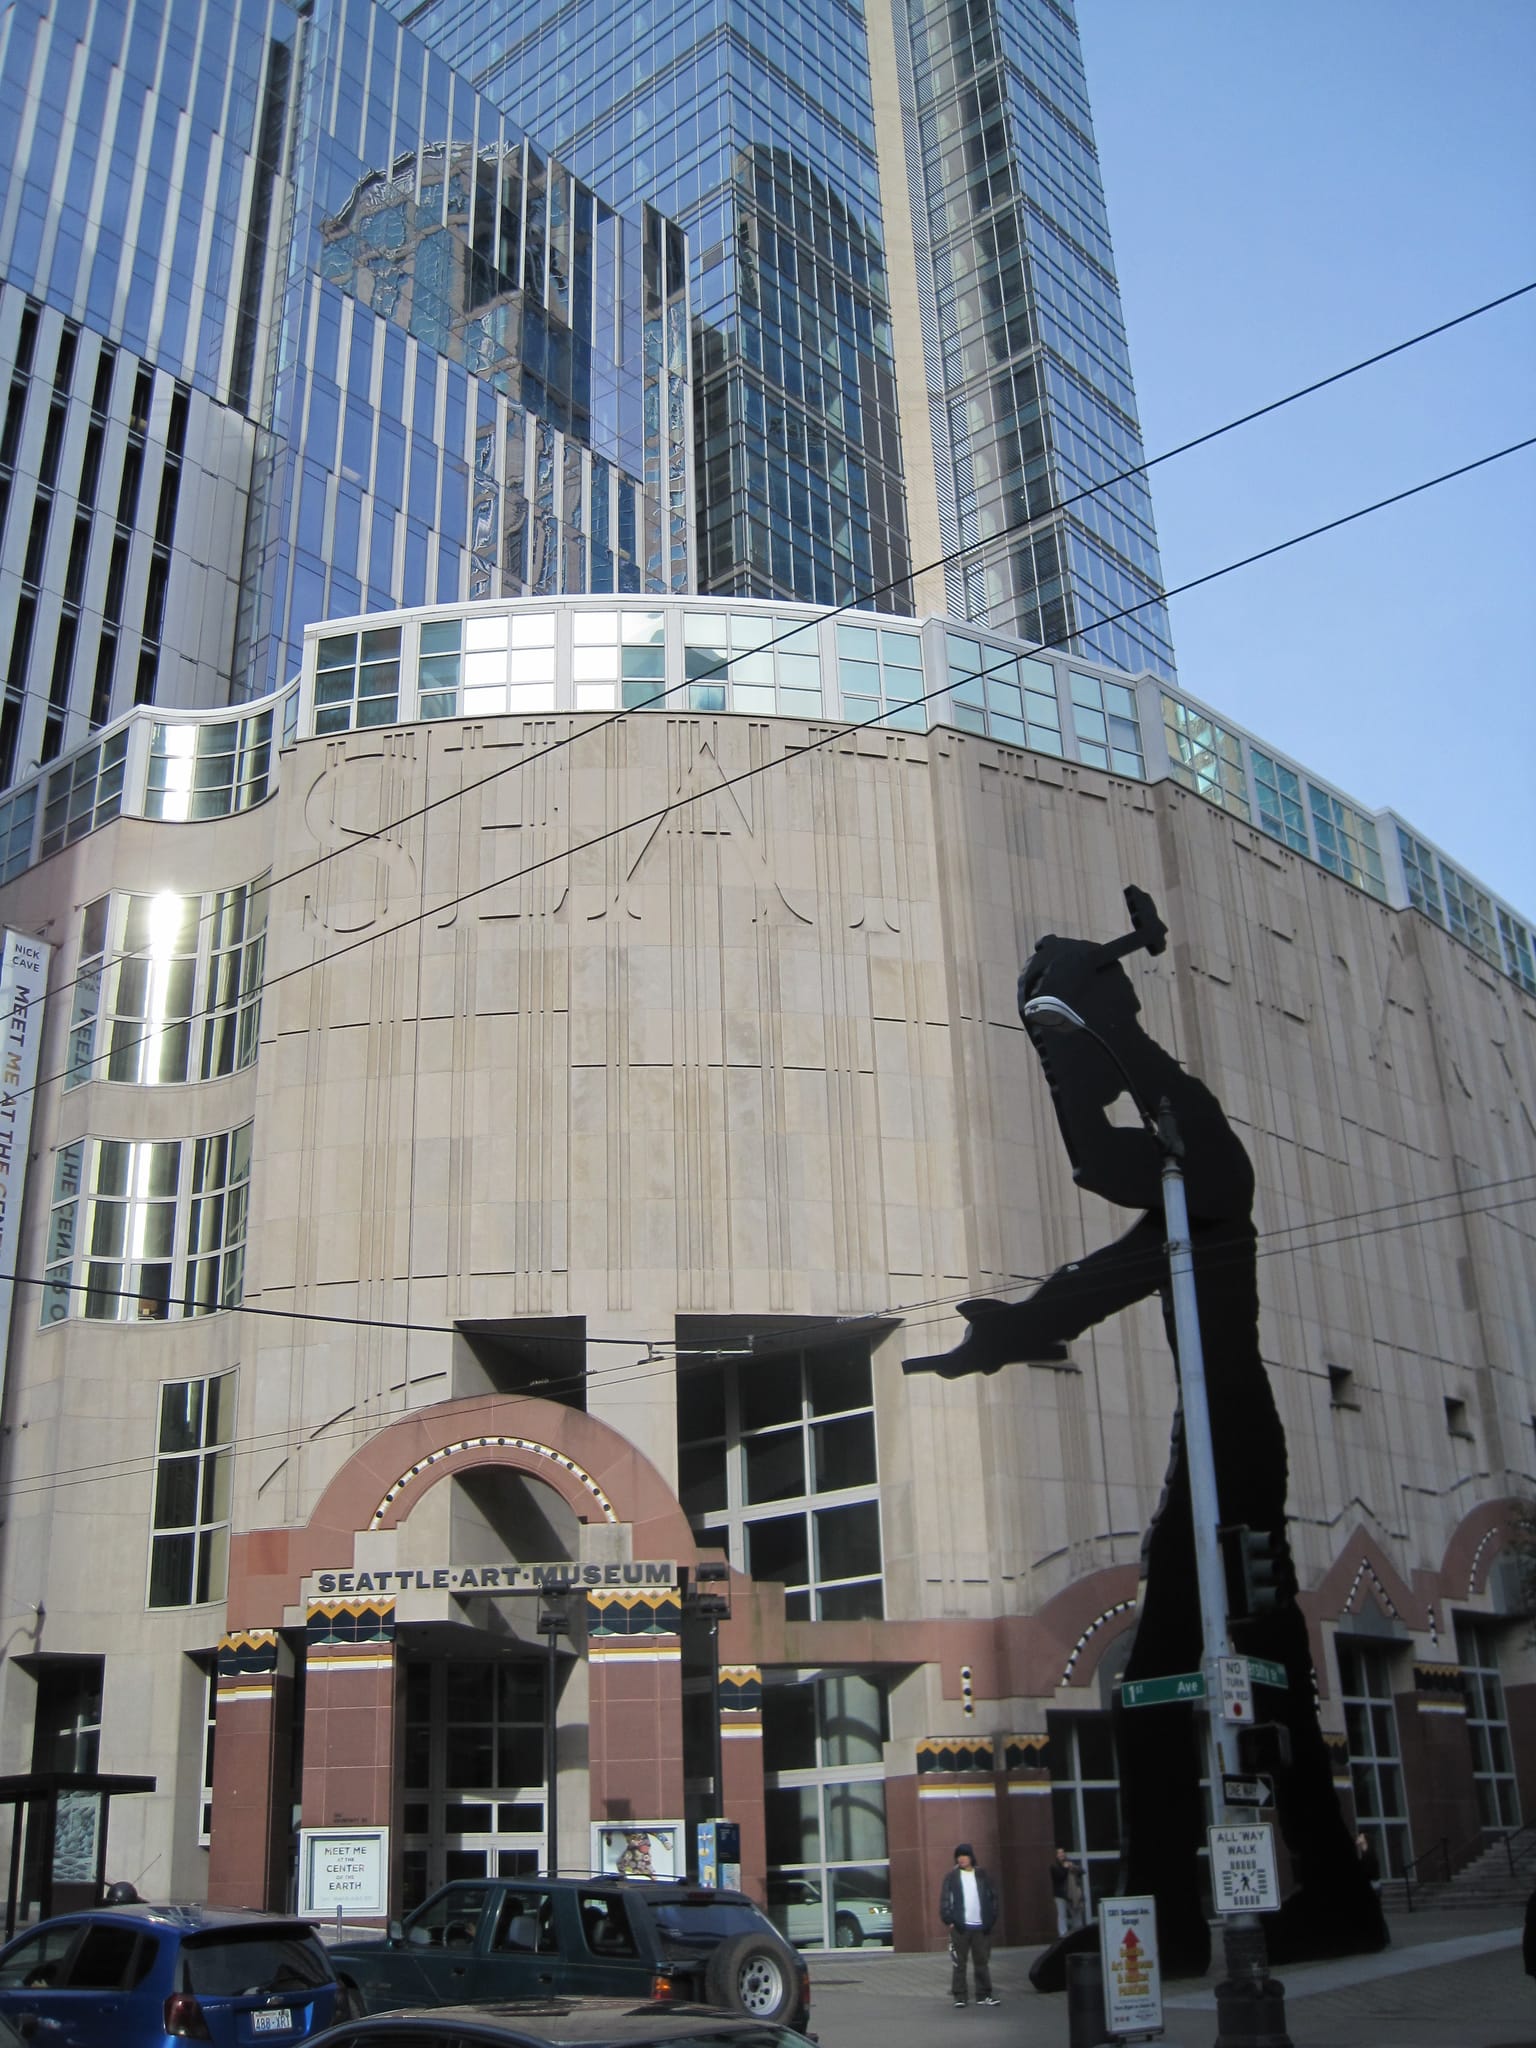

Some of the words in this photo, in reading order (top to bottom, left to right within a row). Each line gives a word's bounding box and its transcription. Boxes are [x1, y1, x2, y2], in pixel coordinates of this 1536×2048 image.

[15, 943, 40, 960] NICK
[12, 956, 40, 973] CAVE
[9, 984, 31, 1048] MEET
[4, 1051, 22, 1088] ME
[1, 1090, 16, 1124] AT
[318, 1569, 449, 1593] SEATTLE
[460, 1567, 521, 1588] ART
[532, 1563, 672, 1586] MUSEUM
[1226, 1662, 1241, 1674] NO
[1176, 1680, 1198, 1695] Ave
[1226, 1678, 1245, 1688] TURN
[1217, 1832, 1238, 1842] ALL
[1242, 1830, 1264, 1841] WAY
[324, 1847, 350, 1856] MEET
[353, 1846, 367, 1855] ME
[1227, 1845, 1257, 1855] WALK
[326, 1864, 365, 1873] CENTER
[329, 1882, 362, 1891] EARTH
